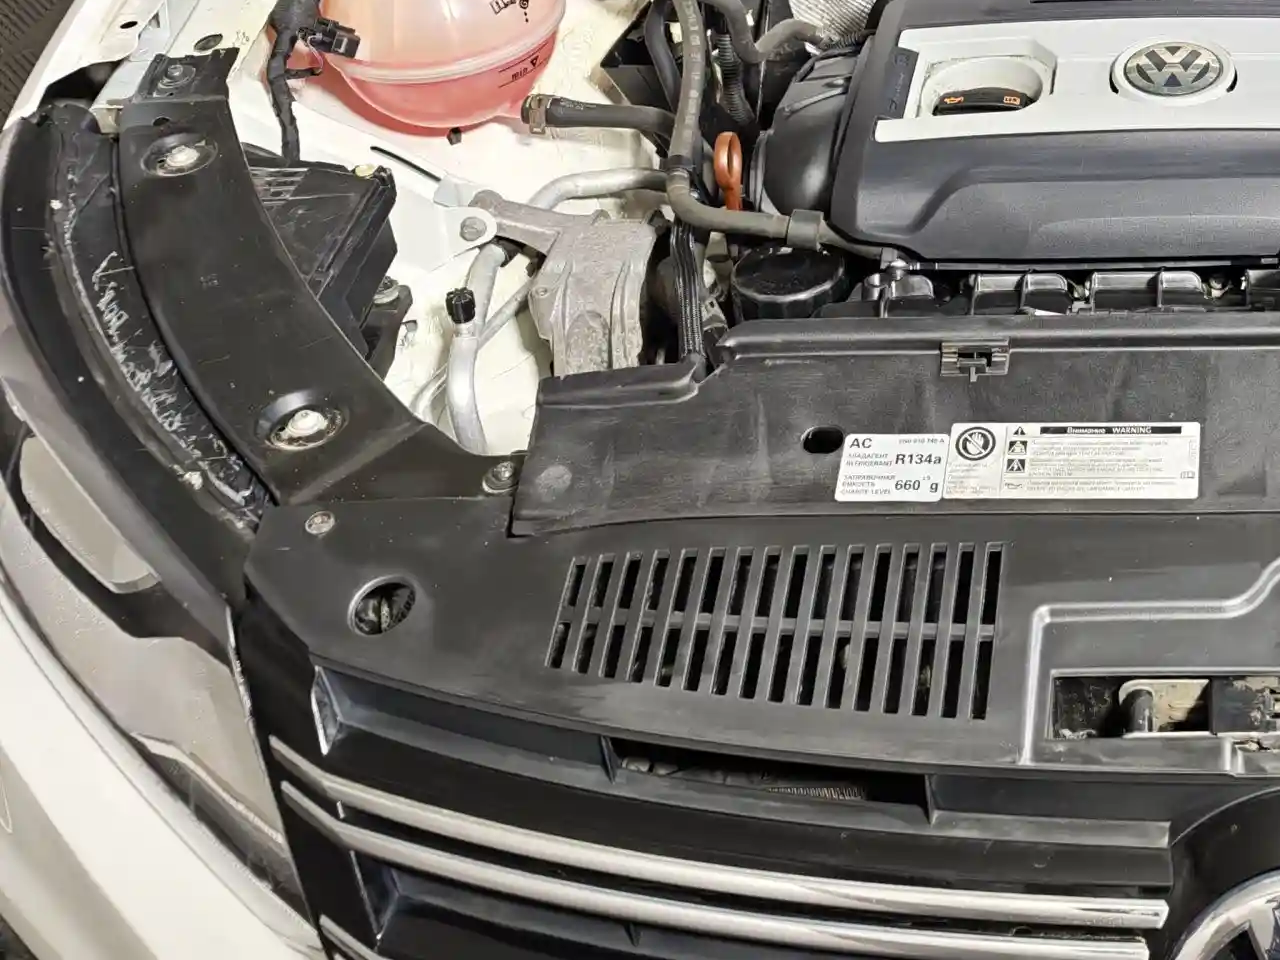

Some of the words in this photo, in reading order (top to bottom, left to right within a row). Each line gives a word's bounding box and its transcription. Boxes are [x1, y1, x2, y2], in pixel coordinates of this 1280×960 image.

[511, 67, 528, 81] min
[1112, 426, 1152, 434] WARNING
[849, 437, 873, 449] AC
[895, 453, 942, 465] R134a
[894, 479, 921, 491] 660
[929, 482, 939, 493] g
